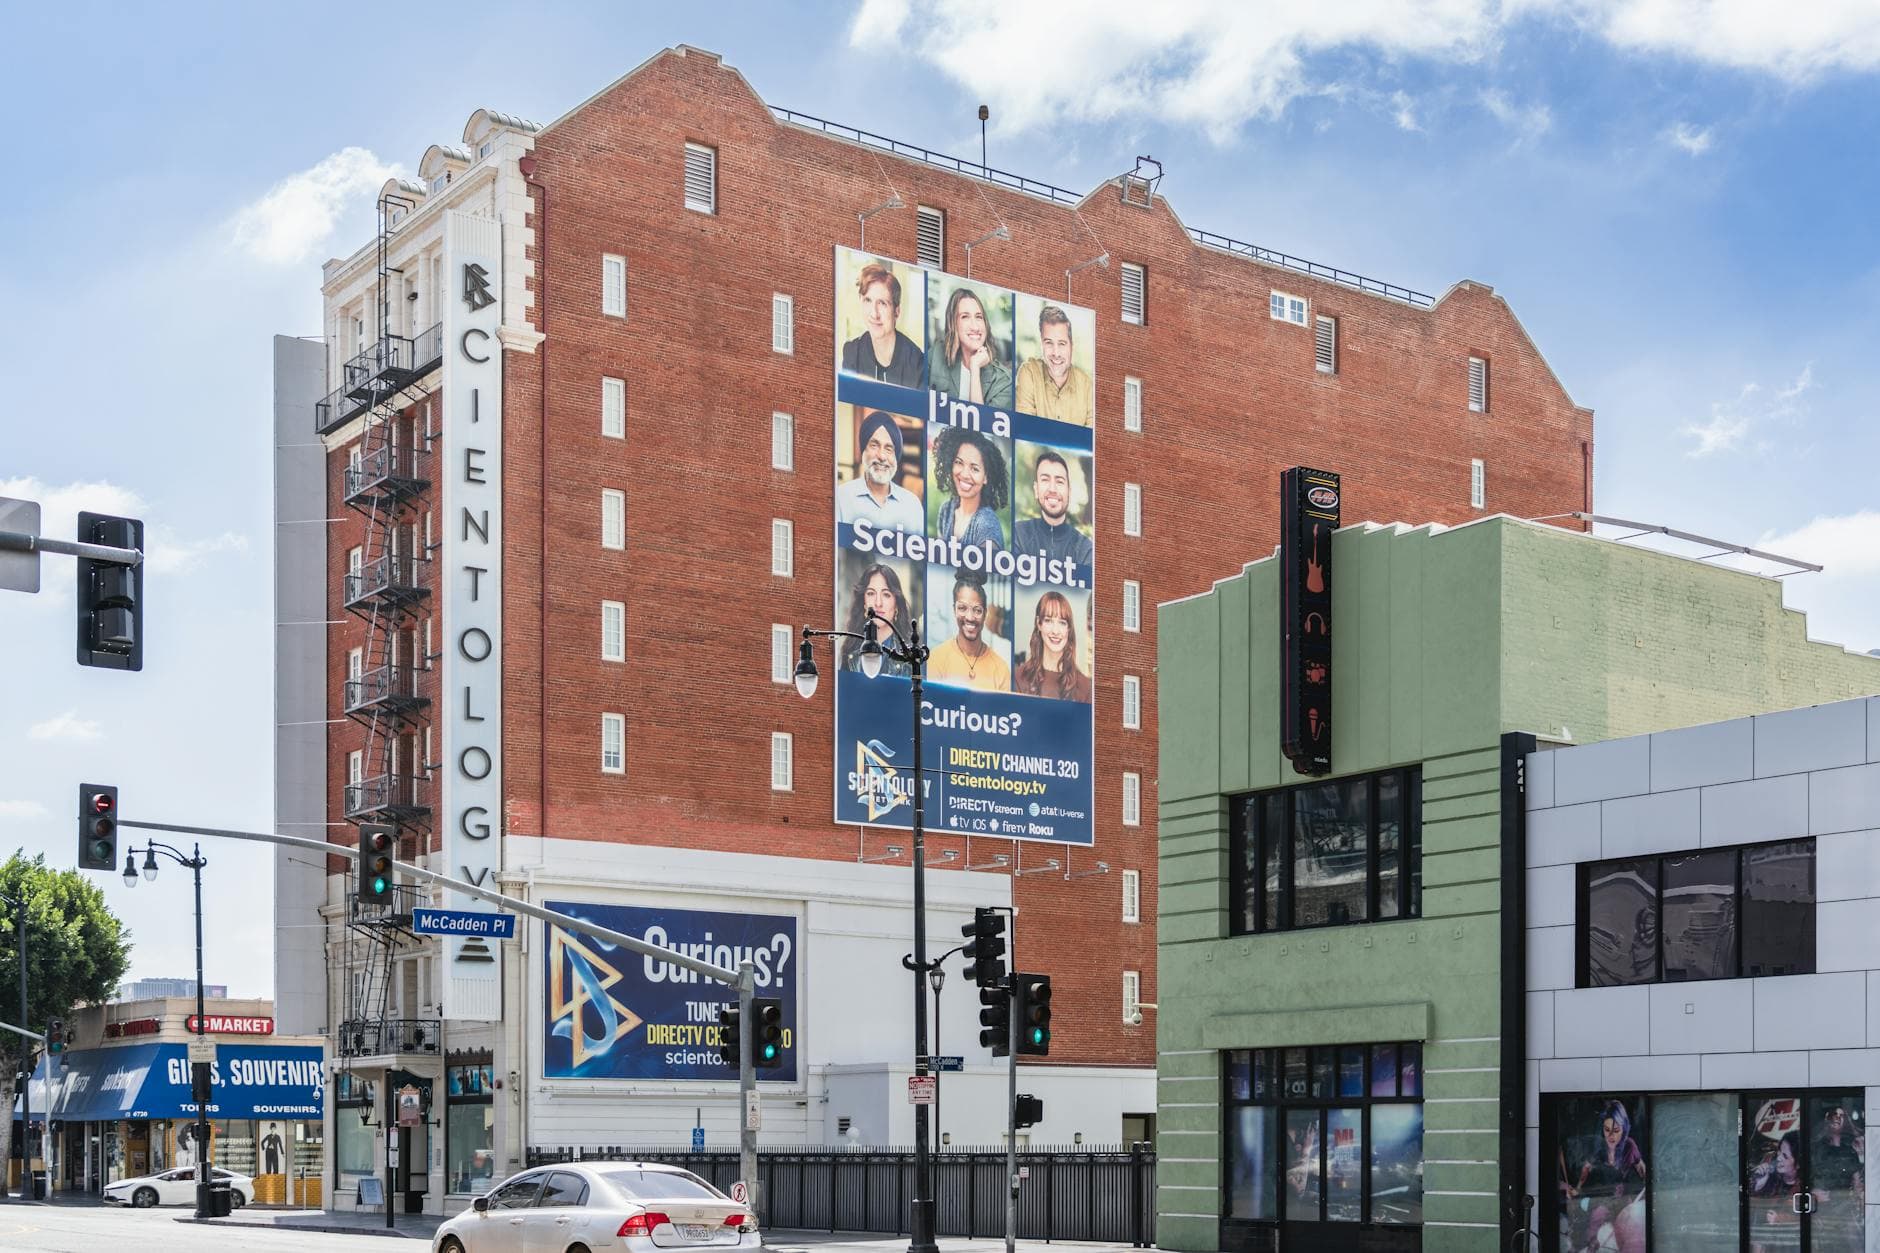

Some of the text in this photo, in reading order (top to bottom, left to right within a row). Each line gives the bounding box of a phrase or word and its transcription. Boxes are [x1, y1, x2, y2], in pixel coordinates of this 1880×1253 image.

[928, 389, 1011, 438] I'm a
[852, 518, 1086, 588] Scientologist.
[921, 700, 1022, 737] Curious?
[949, 747, 1079, 780] DIRECTV CHANNEL 320
[848, 771, 932, 799] SCIENTOLOY
[950, 772, 1047, 796] scientology.tv
[972, 818, 987, 831] iOS
[421, 914, 506, 933] McCadden Pl
[686, 1001, 720, 1023] TUNE
[210, 1017, 270, 1033] MARKET
[646, 1023, 703, 1046] DIRECTV
[167, 1058, 226, 1088] GIS,
[253, 1105, 320, 1115] SOUVENIRS,
